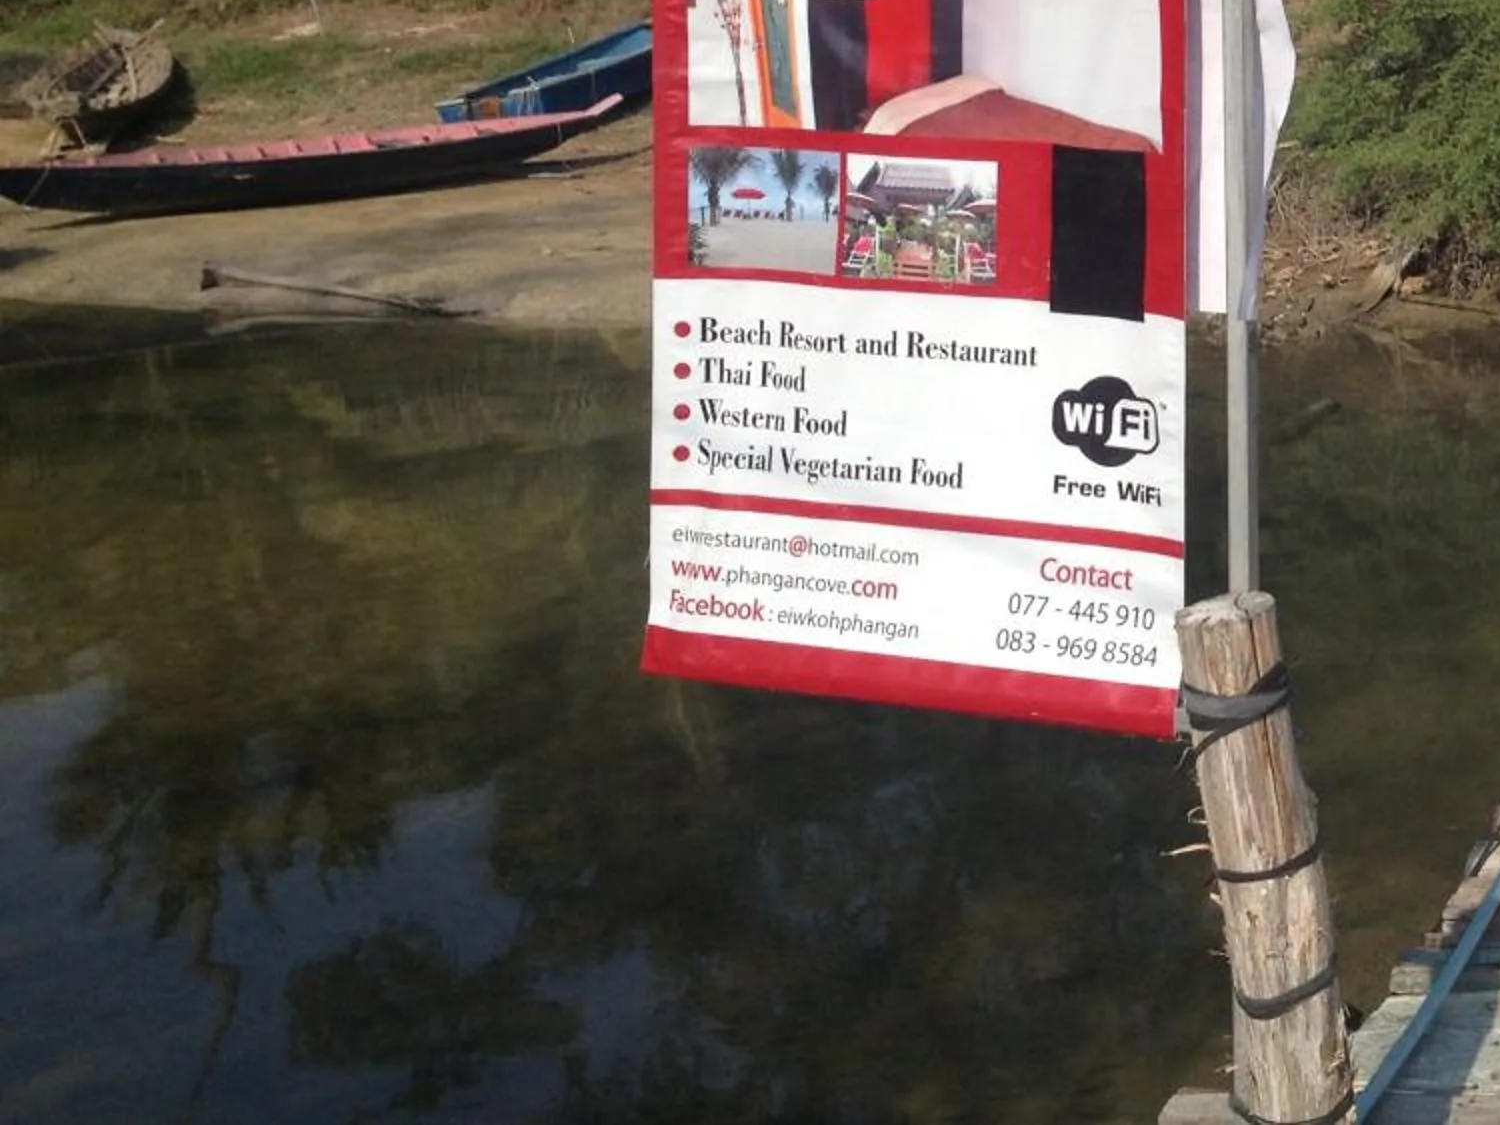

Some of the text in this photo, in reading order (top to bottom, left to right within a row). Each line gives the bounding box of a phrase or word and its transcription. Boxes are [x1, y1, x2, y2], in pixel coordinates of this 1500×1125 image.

[700, 317, 1038, 366] Beach Resort and Restaurant
[699, 357, 806, 392] Thai Food
[699, 399, 847, 437] Western Food
[697, 438, 963, 489] Special Vegetarian Food
[1053, 475, 1162, 507] Free WiFi
[672, 527, 919, 566] eiwrestaurant@hotmail.com
[672, 559, 897, 600] www.phangancove.com
[1039, 557, 1133, 590] Contact
[669, 589, 764, 621] Facebook
[777, 607, 919, 641] eiwkohphangan
[1008, 593, 1049, 617] 077
[1068, 600, 1109, 624] 445
[1116, 605, 1155, 630] 910
[996, 628, 1036, 654] 083
[1057, 635, 1097, 660] 969
[1102, 641, 1157, 667] 8584
